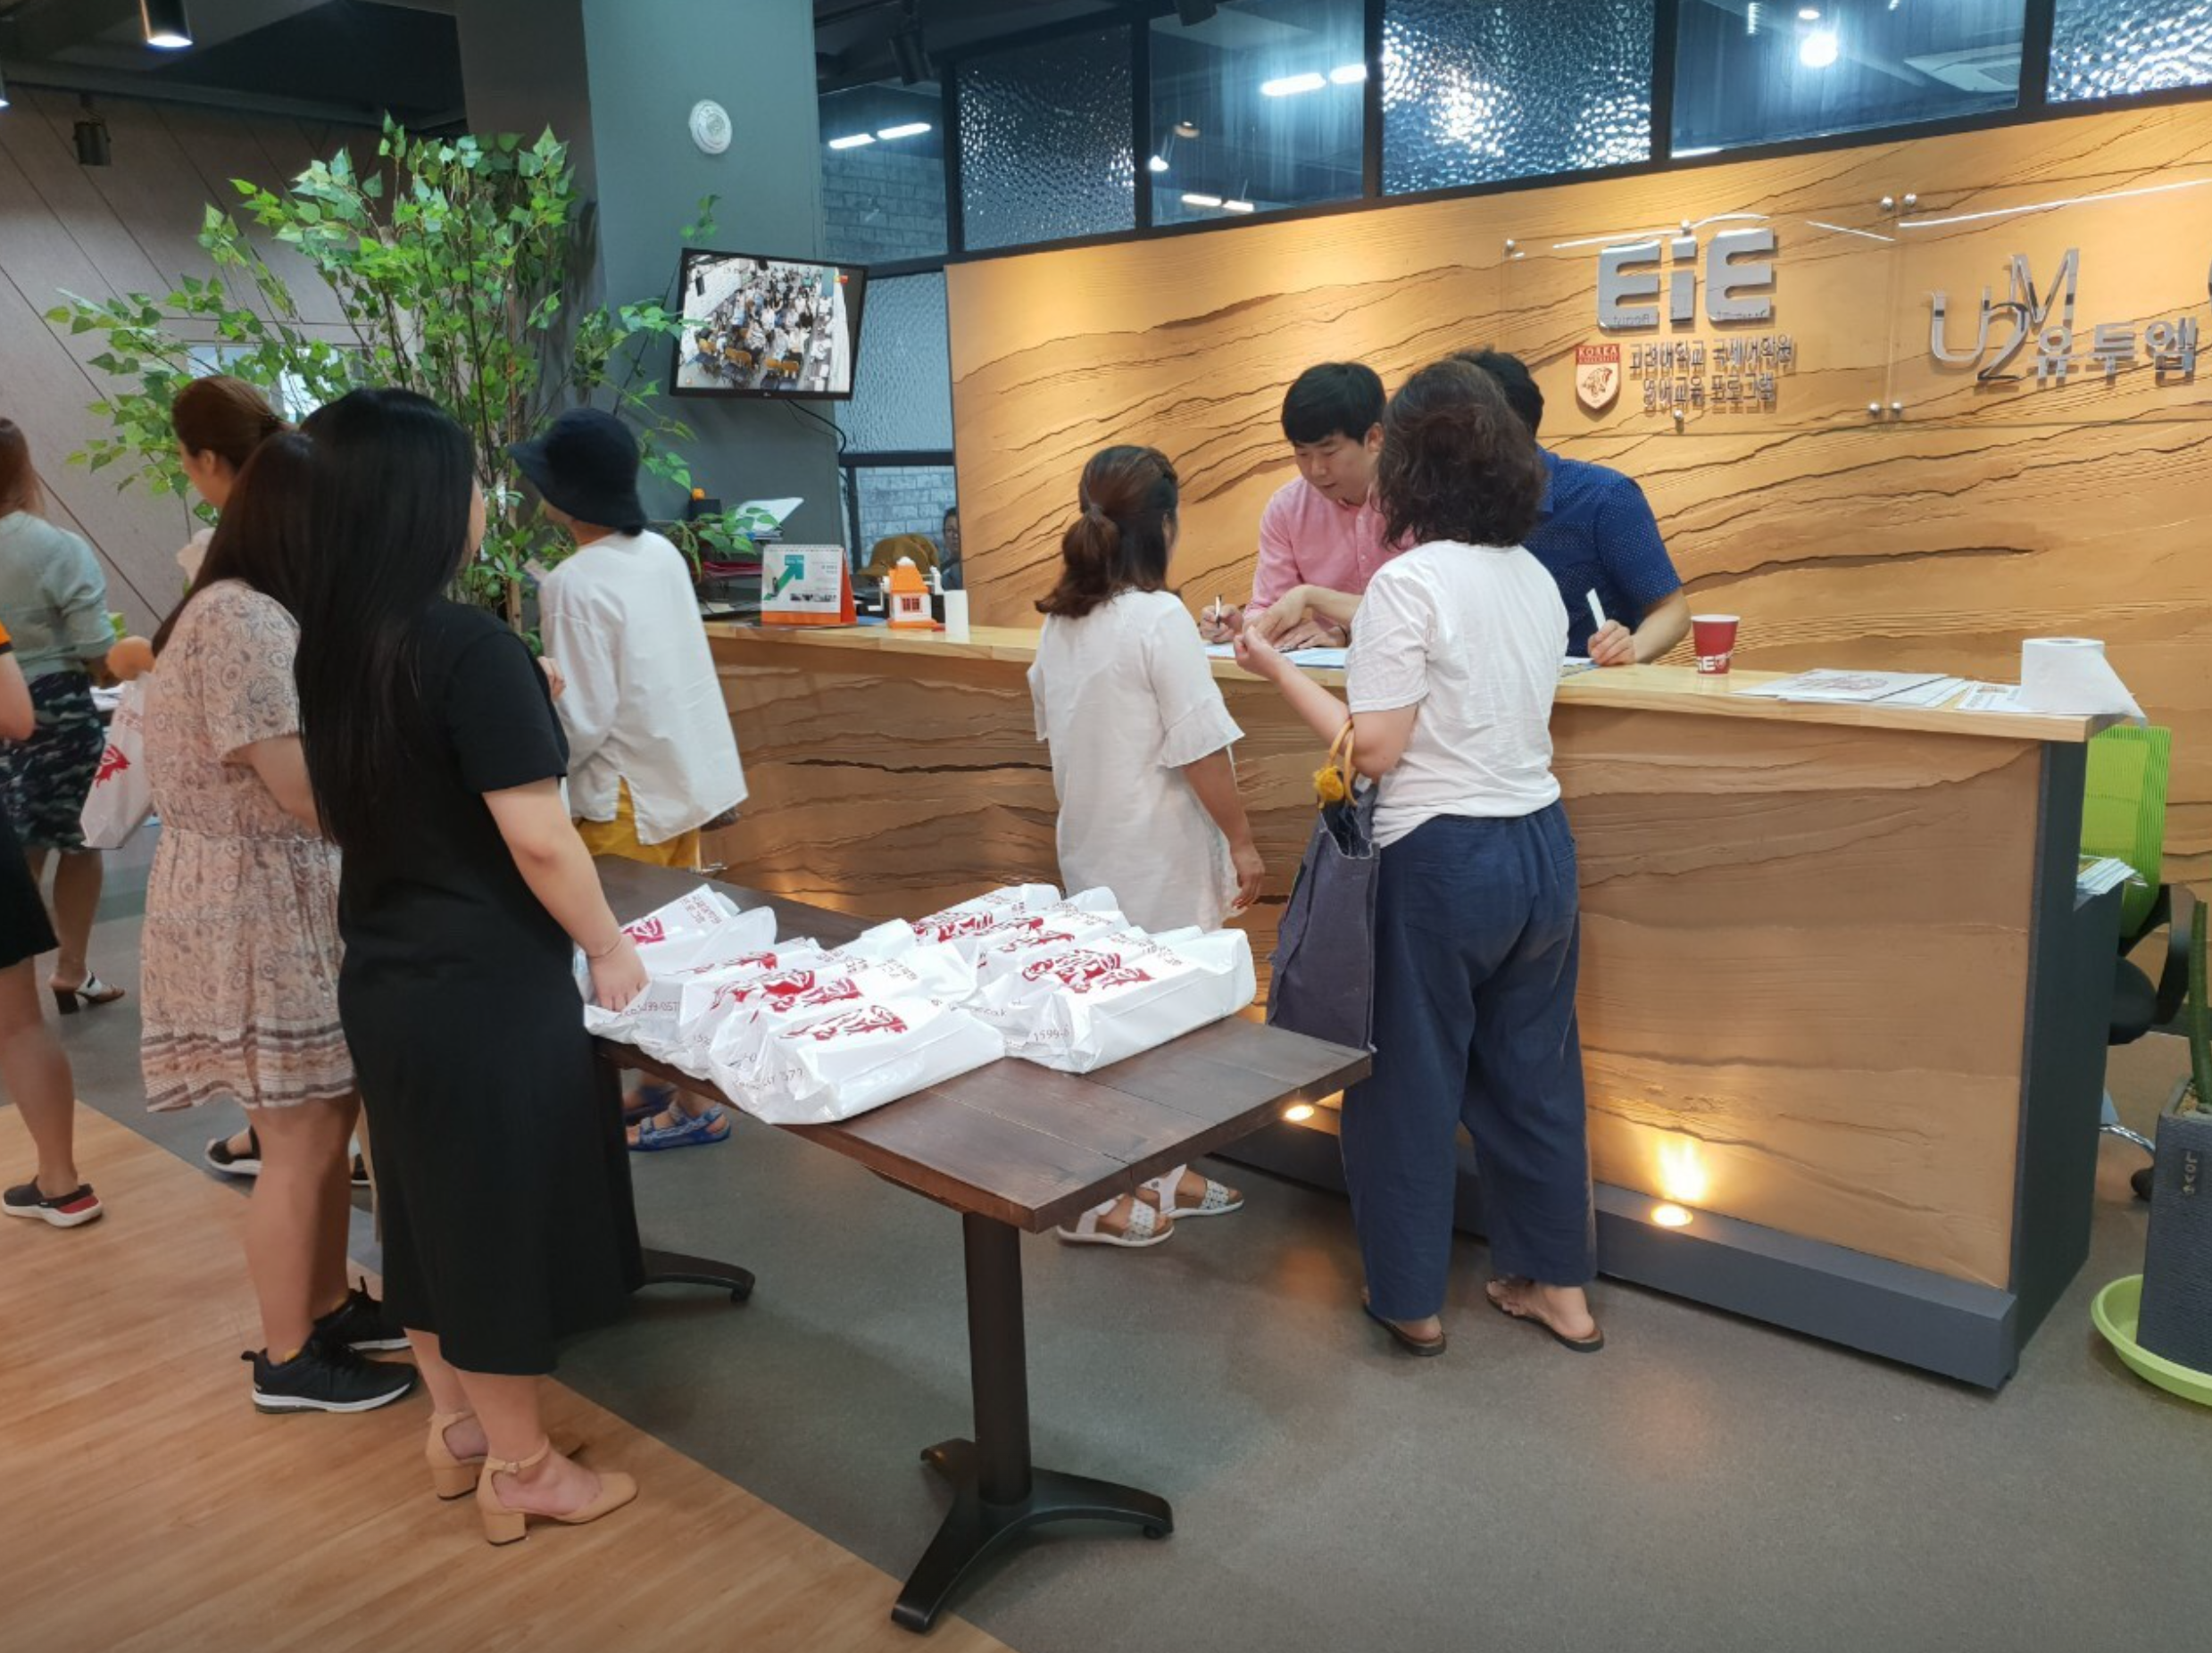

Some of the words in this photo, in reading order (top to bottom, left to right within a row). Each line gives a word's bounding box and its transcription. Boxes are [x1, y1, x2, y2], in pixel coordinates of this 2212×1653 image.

[1597, 228, 1775, 328] EiE
[1629, 339, 1704, 371] 고려대학교
[2028, 317, 2198, 379] 유투엠
[1643, 375, 1703, 408] 영어교육
[1710, 371, 1775, 402] 프로그램
